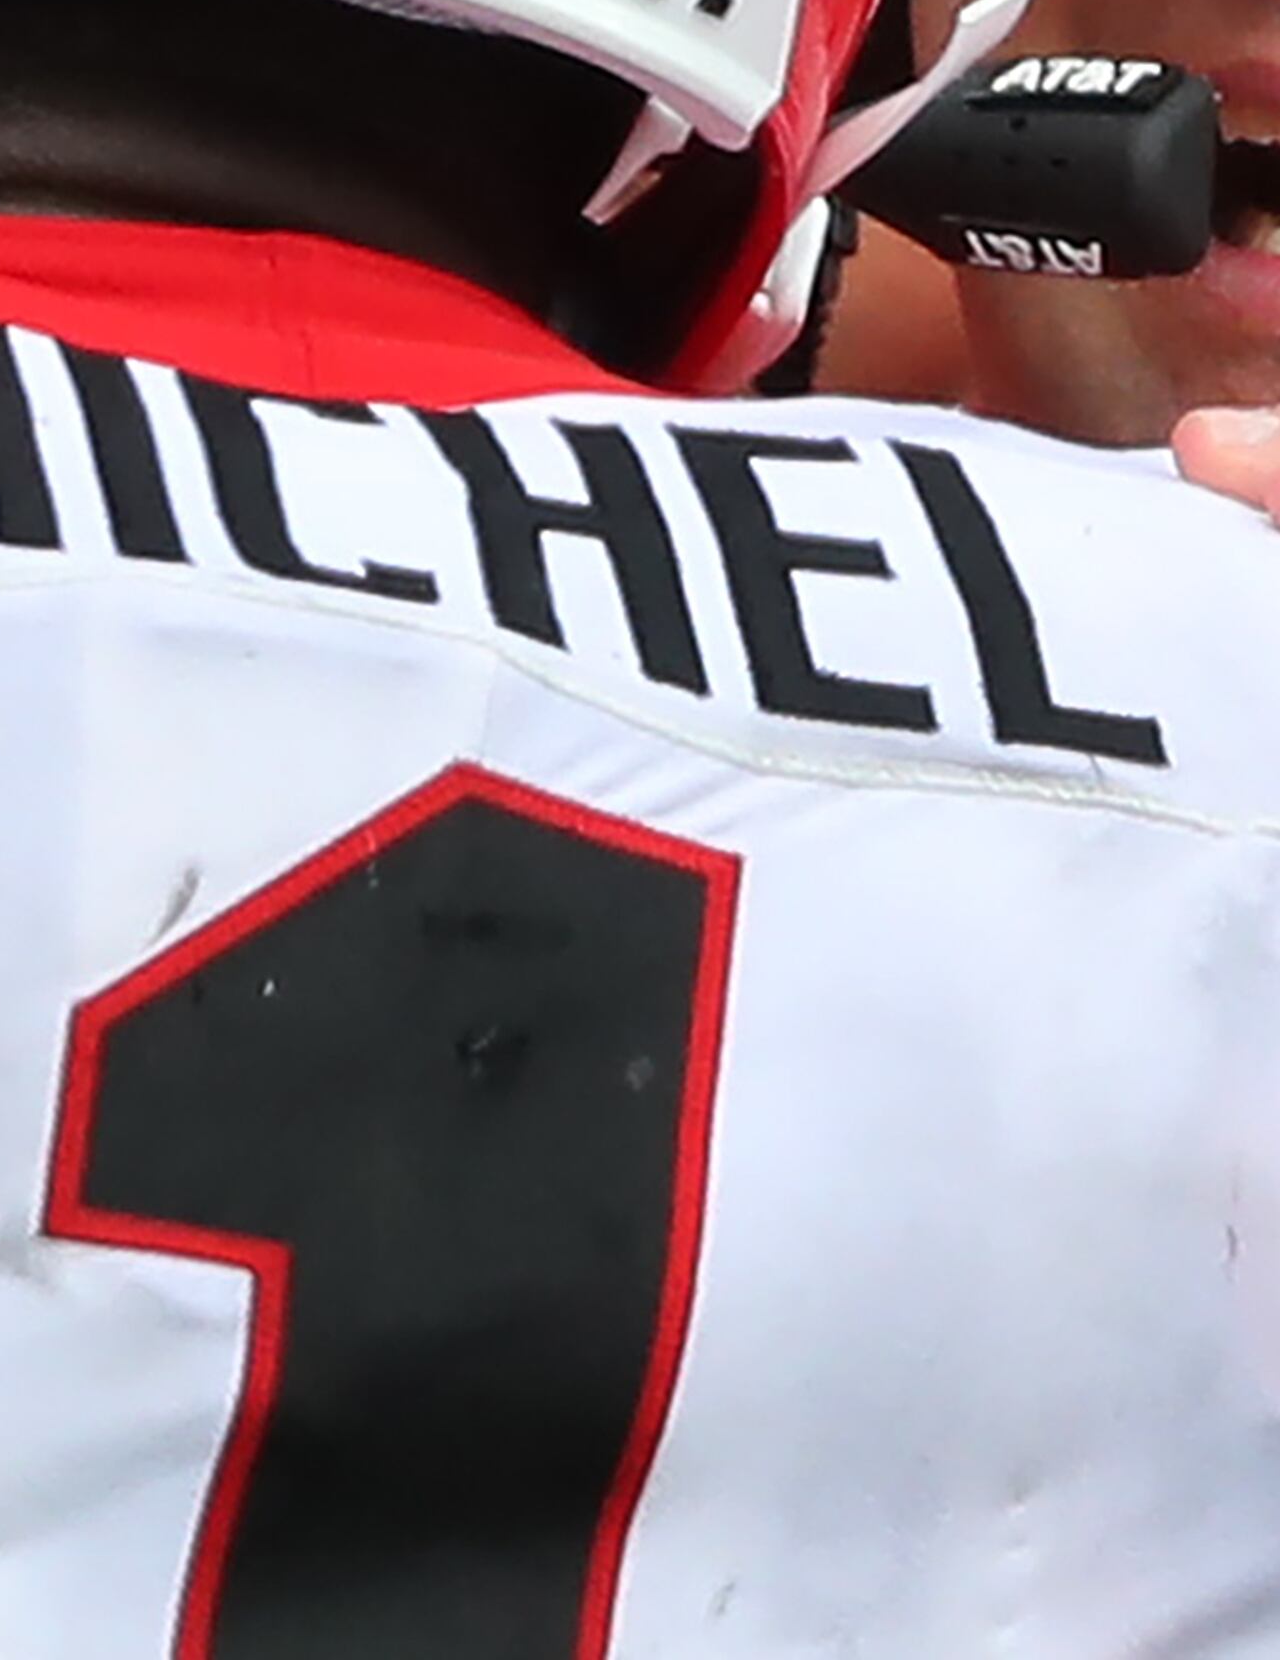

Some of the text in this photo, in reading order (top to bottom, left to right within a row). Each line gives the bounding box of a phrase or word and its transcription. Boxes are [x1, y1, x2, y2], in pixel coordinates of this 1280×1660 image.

[991, 57, 1162, 94] AT&T
[965, 229, 1103, 276] AT&T
[40, 760, 745, 1660] 1
